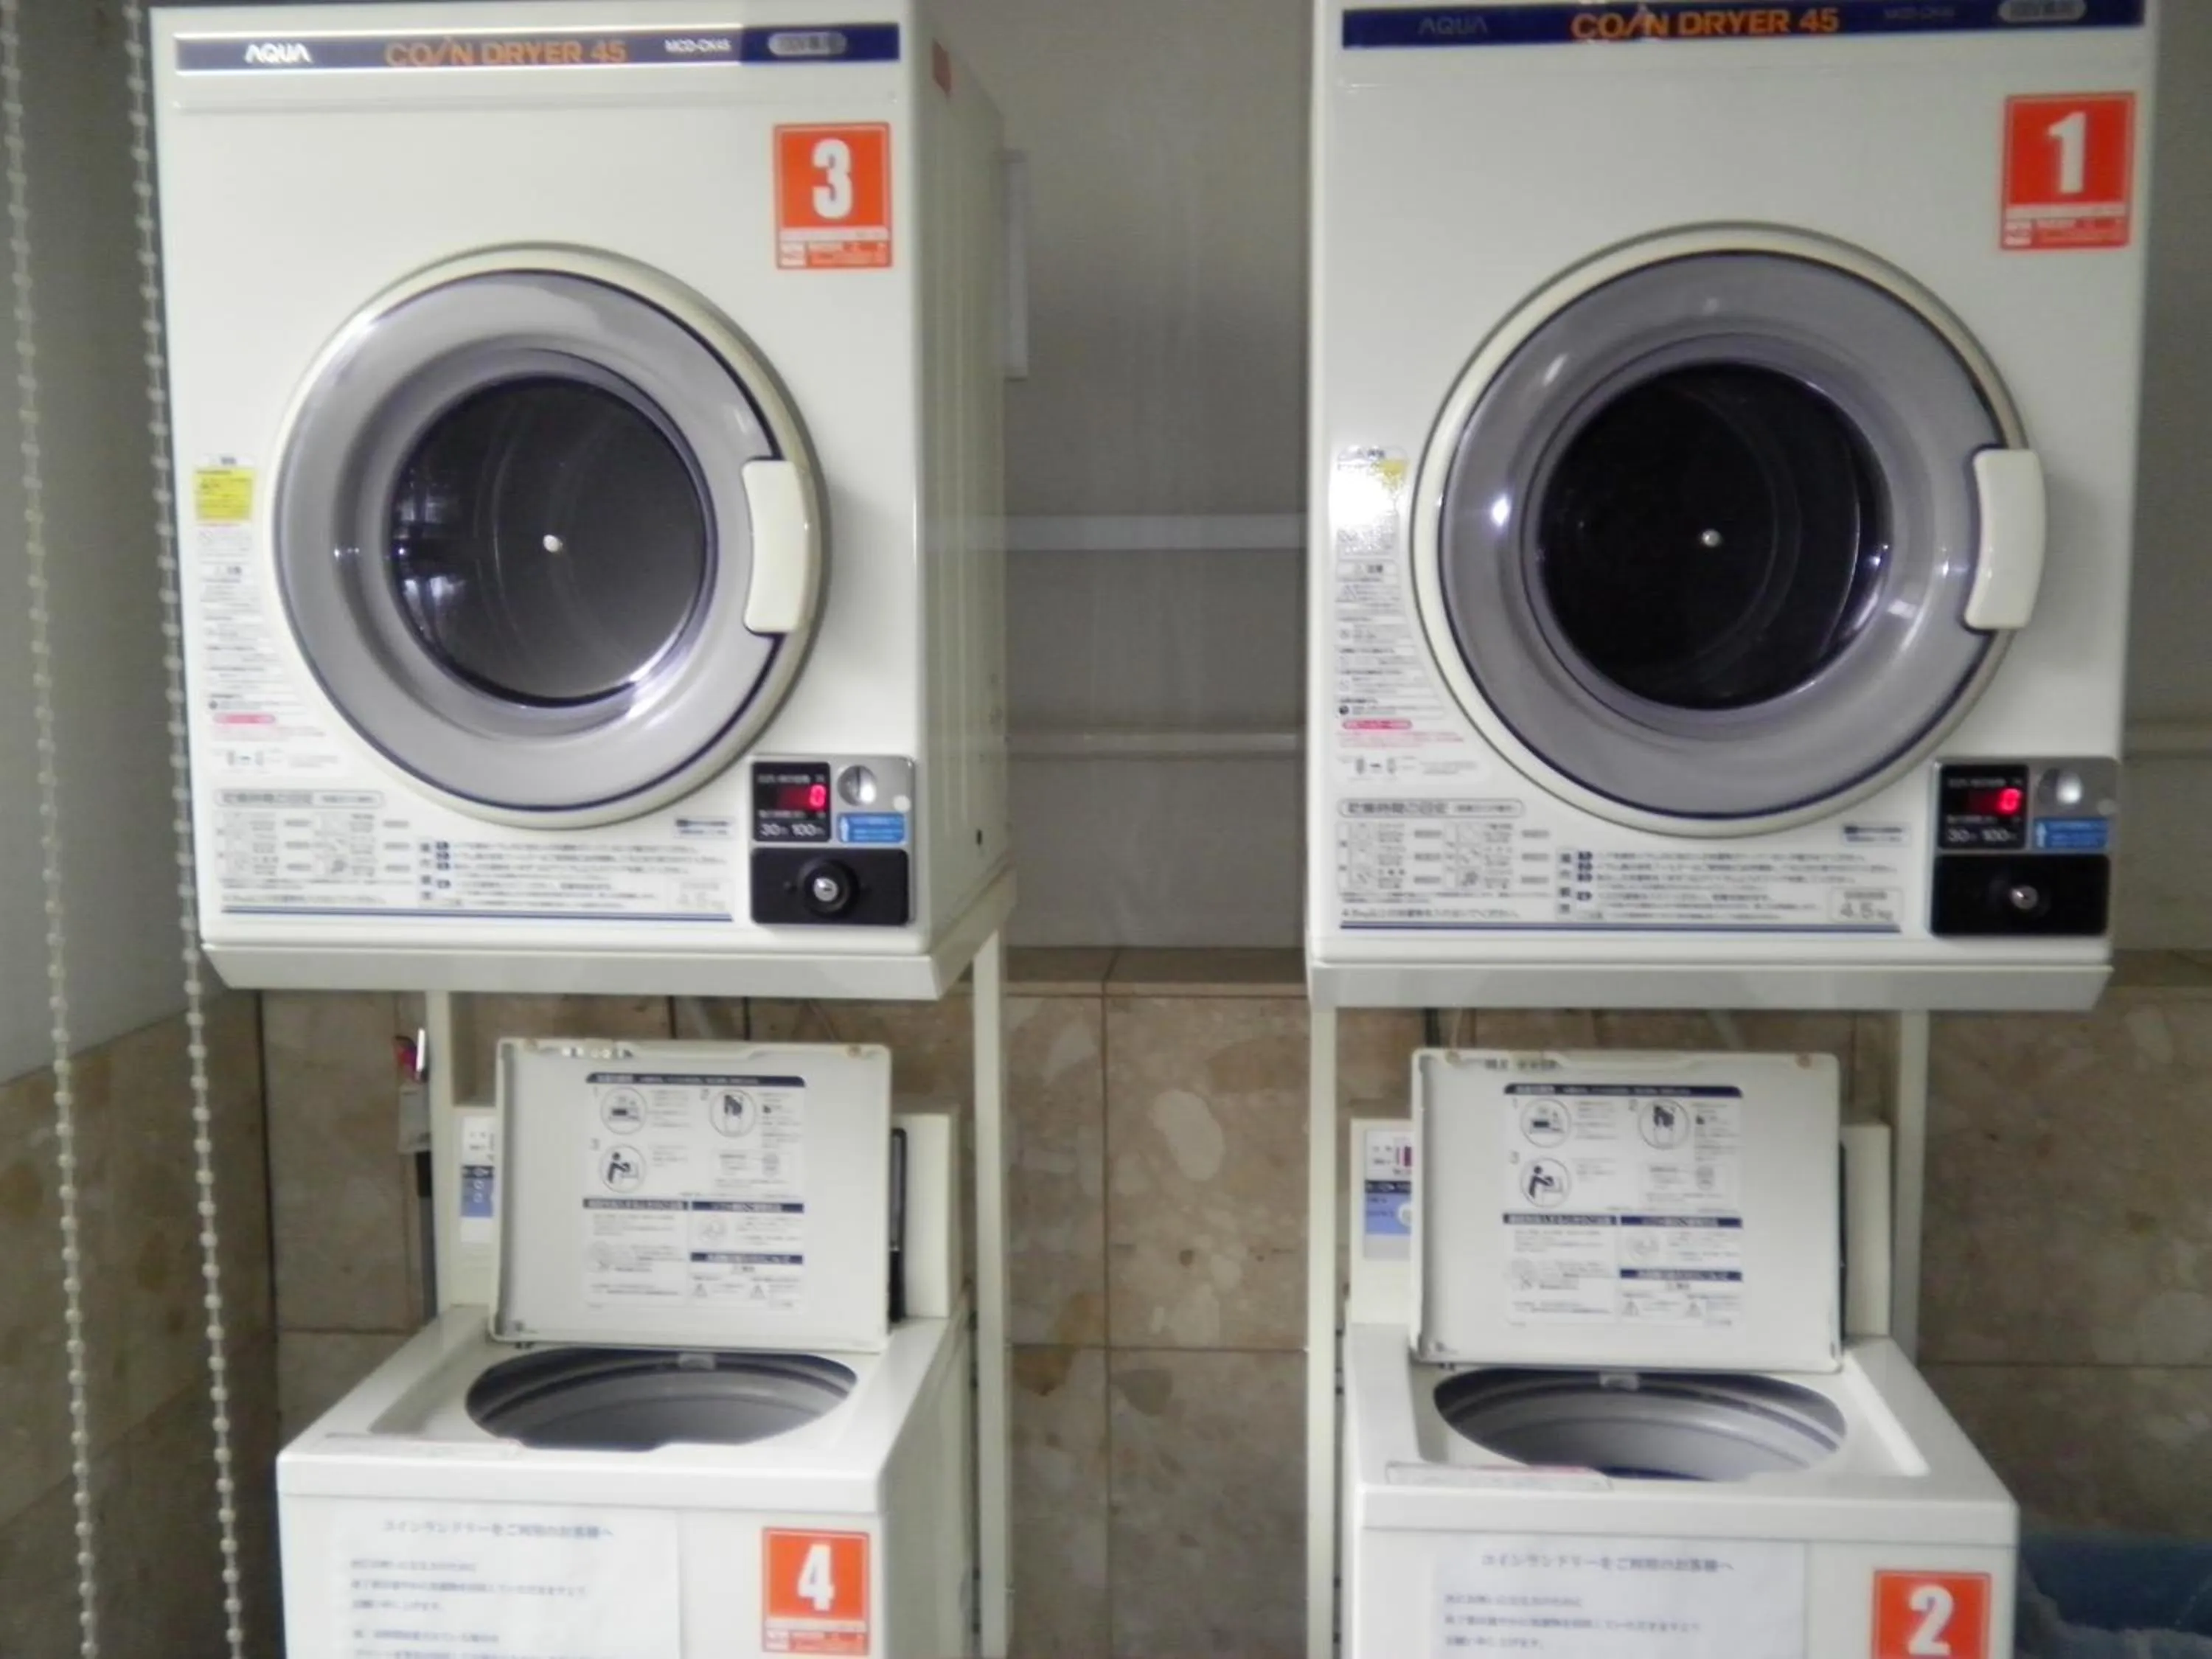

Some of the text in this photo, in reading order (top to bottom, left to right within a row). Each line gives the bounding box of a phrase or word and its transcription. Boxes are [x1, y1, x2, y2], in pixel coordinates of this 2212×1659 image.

[1417, 15, 1489, 35] AQUA
[1677, 9, 1790, 36] DRYER
[1798, 7, 1840, 33] 45
[244, 42, 313, 64] AQUA
[481, 41, 582, 65] DRYER
[591, 38, 626, 63] 45
[2047, 111, 2086, 194] 1
[813, 137, 852, 220] 3
[797, 1543, 836, 1612] 4
[1908, 1585, 1954, 1655] 2
